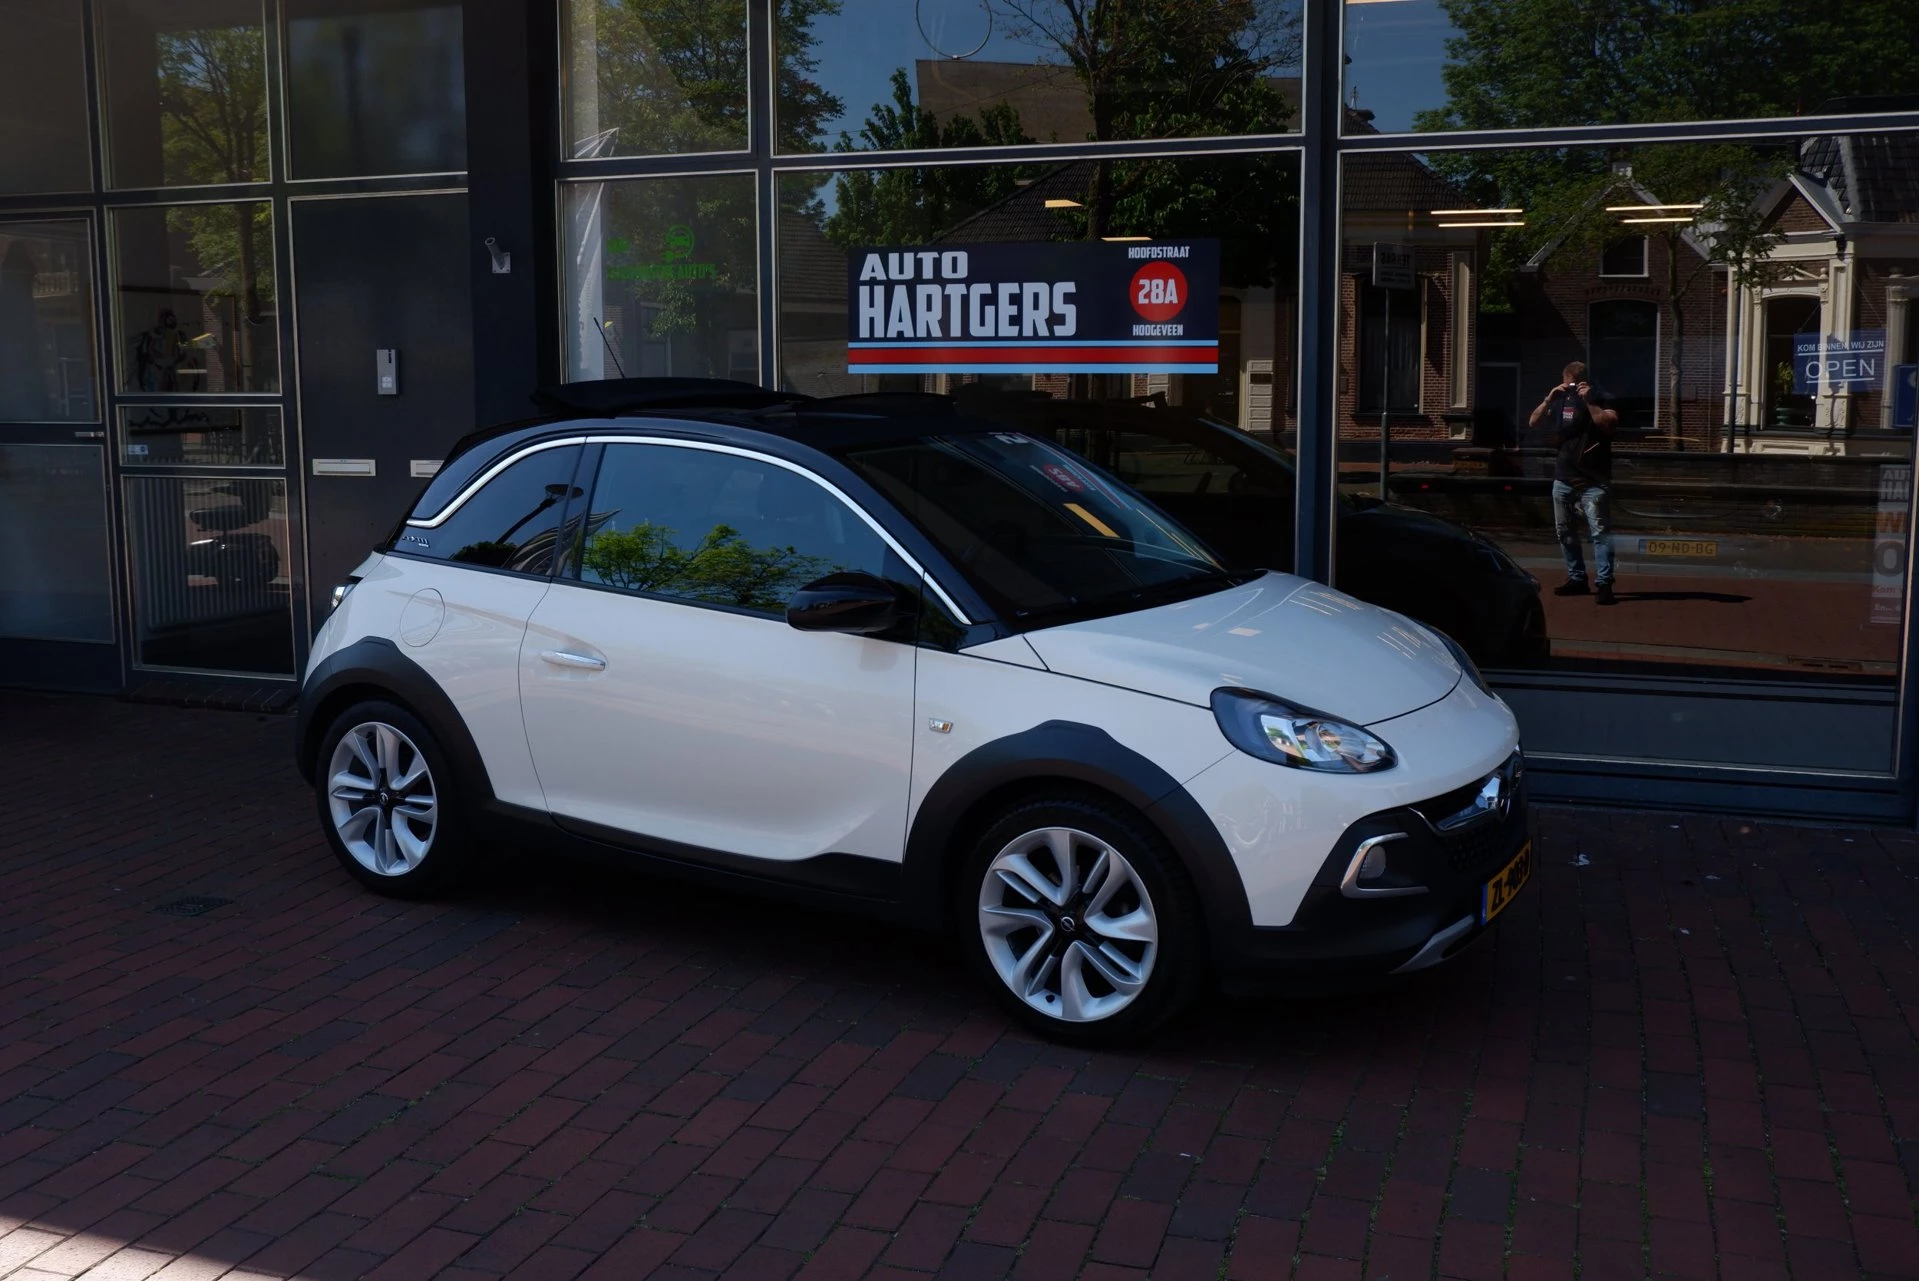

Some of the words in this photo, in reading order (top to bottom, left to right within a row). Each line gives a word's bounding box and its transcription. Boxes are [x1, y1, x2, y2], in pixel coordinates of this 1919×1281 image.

[1128, 246, 1190, 259] HOOFDSTRAAT
[859, 250, 969, 281] AUTO
[1137, 278, 1178, 305] 28A
[859, 281, 1077, 339] HARTGERS
[1132, 323, 1184, 336] HOOGEVEEN
[1797, 343, 1816, 352] KOM
[1818, 341, 1850, 351] BNNEN,
[1851, 340, 1866, 349] WIJ
[1867, 340, 1885, 349] ZIJN
[1805, 358, 1875, 379] OPEN
